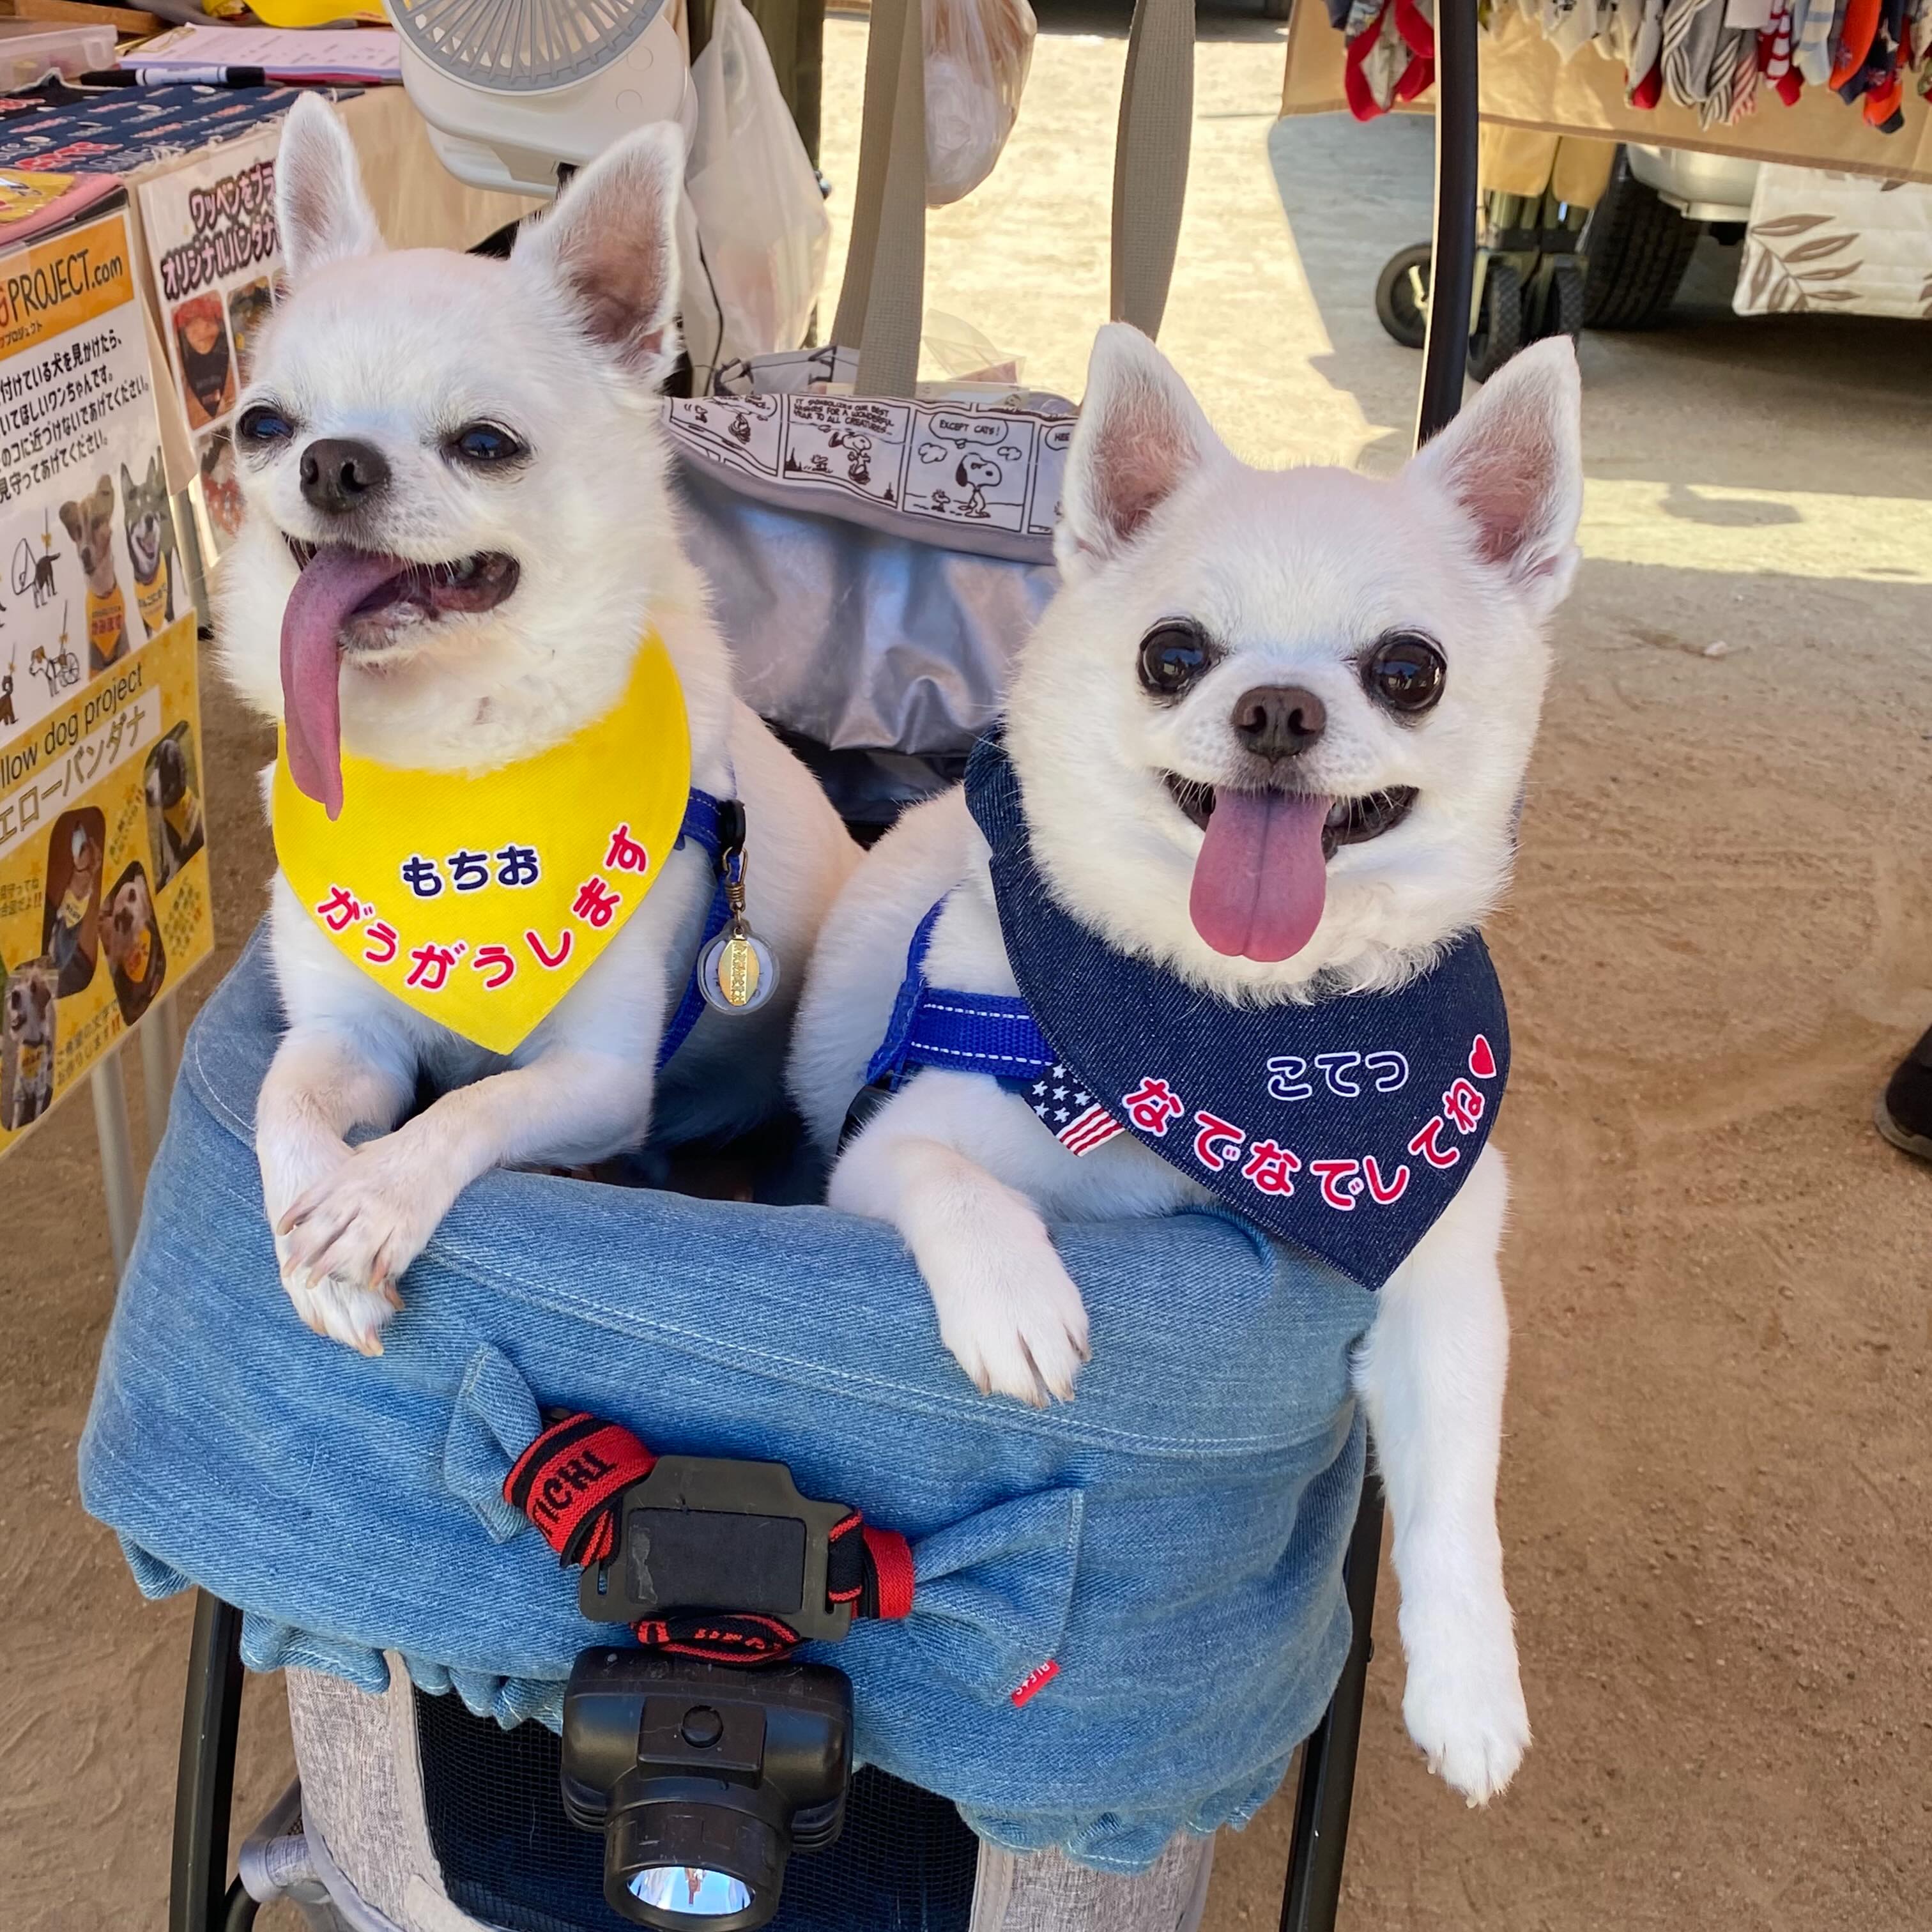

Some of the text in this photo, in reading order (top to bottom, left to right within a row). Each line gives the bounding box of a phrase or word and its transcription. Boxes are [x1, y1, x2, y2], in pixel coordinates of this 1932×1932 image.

[939, 419, 969, 432] EXCEPT
[44, 712, 79, 755] dog
[84, 662, 142, 735] project
[401, 844, 541, 898] もちお
[314, 822, 650, 992] がうがうします
[1266, 1050, 1410, 1101] こてつ
